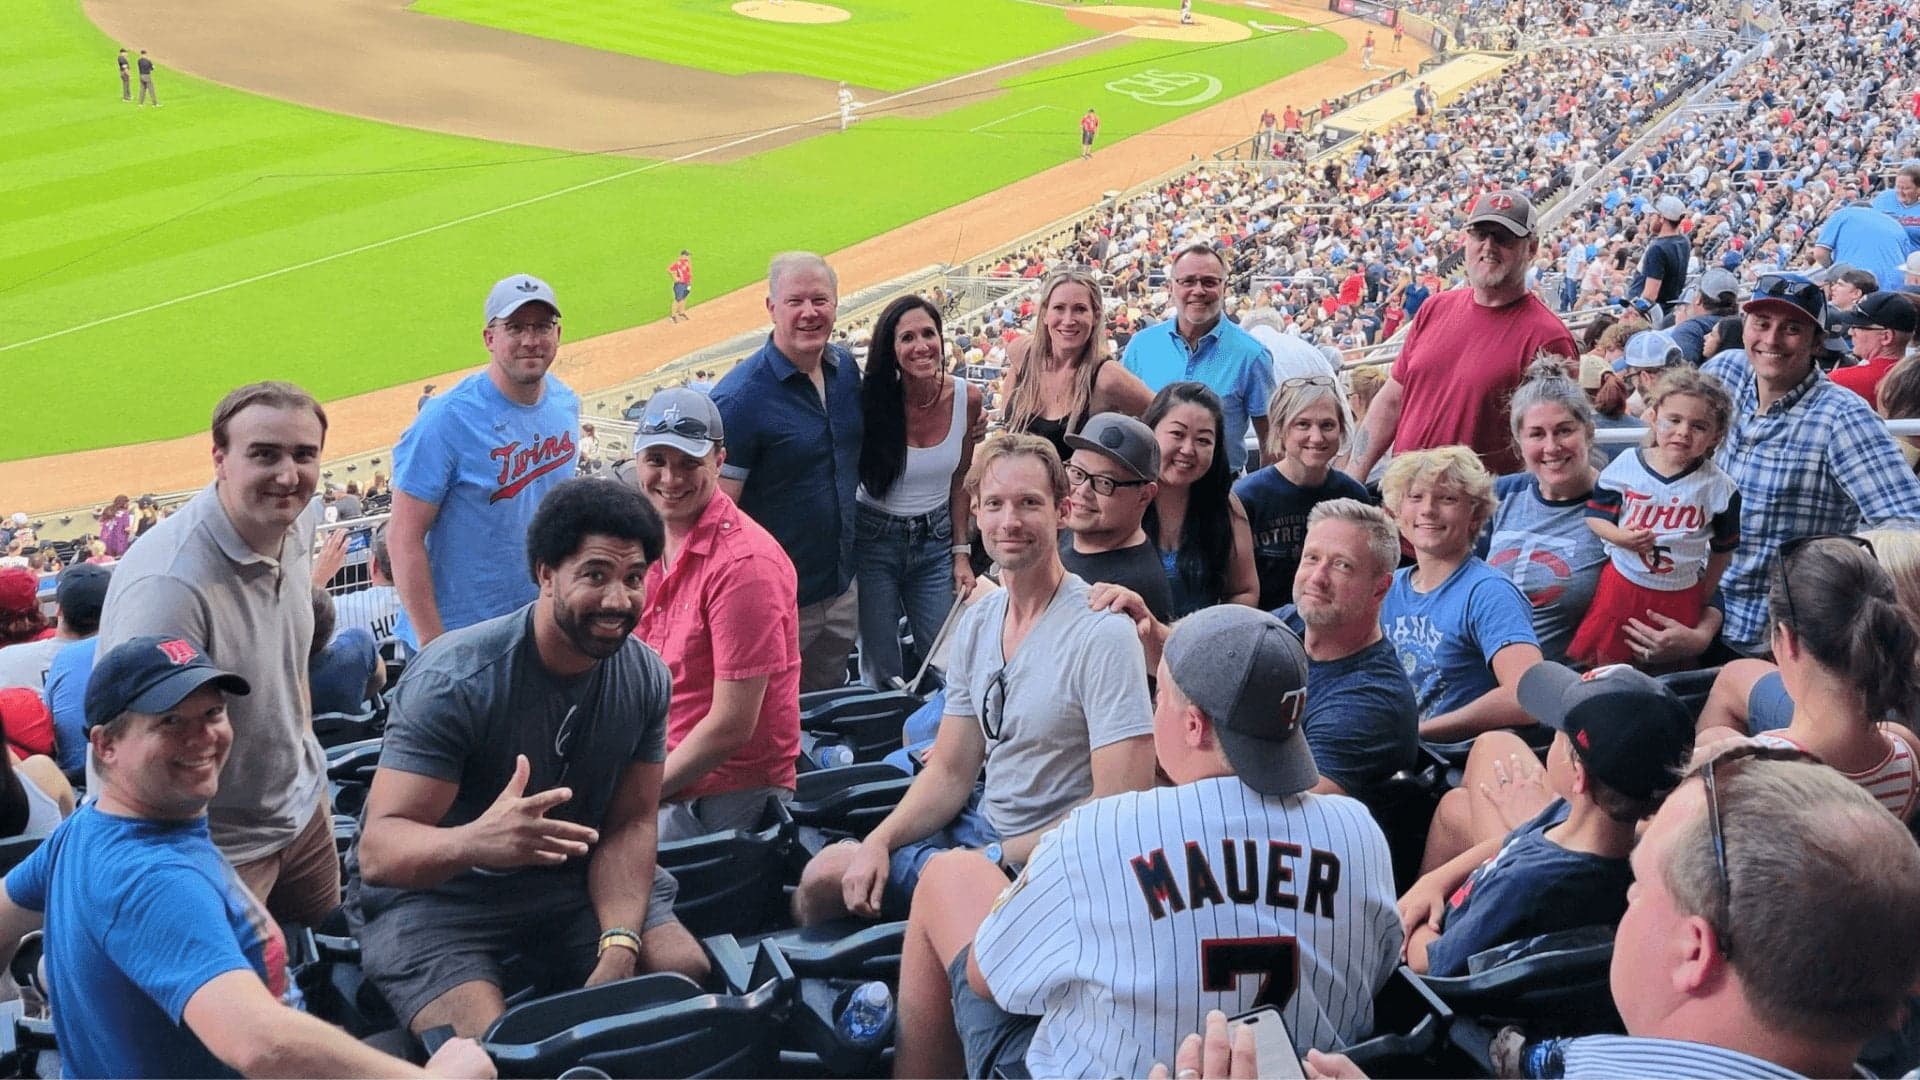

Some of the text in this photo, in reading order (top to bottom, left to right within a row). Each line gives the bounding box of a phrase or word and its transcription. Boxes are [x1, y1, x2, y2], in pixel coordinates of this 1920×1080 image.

[490, 431, 575, 486] Twins
[1130, 838, 1341, 921] MAUER
[1201, 936, 1298, 1013] 7
